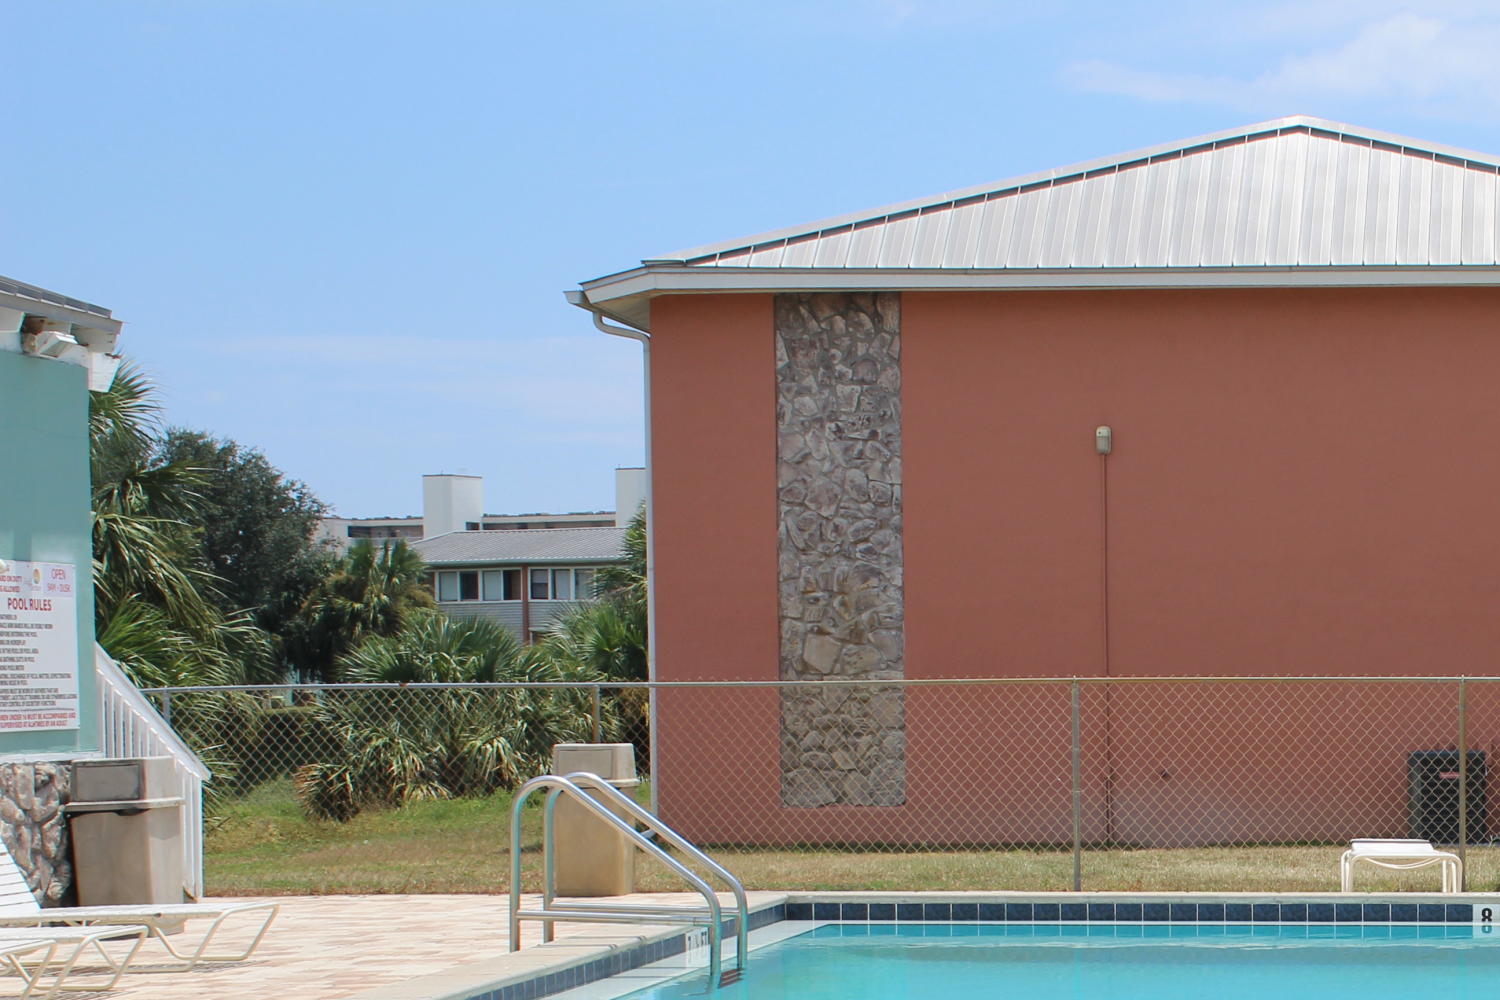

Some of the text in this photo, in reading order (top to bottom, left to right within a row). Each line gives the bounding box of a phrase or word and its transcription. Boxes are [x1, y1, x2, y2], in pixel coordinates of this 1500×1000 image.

[7, 597, 52, 611] POOL RULES
[1481, 907, 1493, 922] 8
